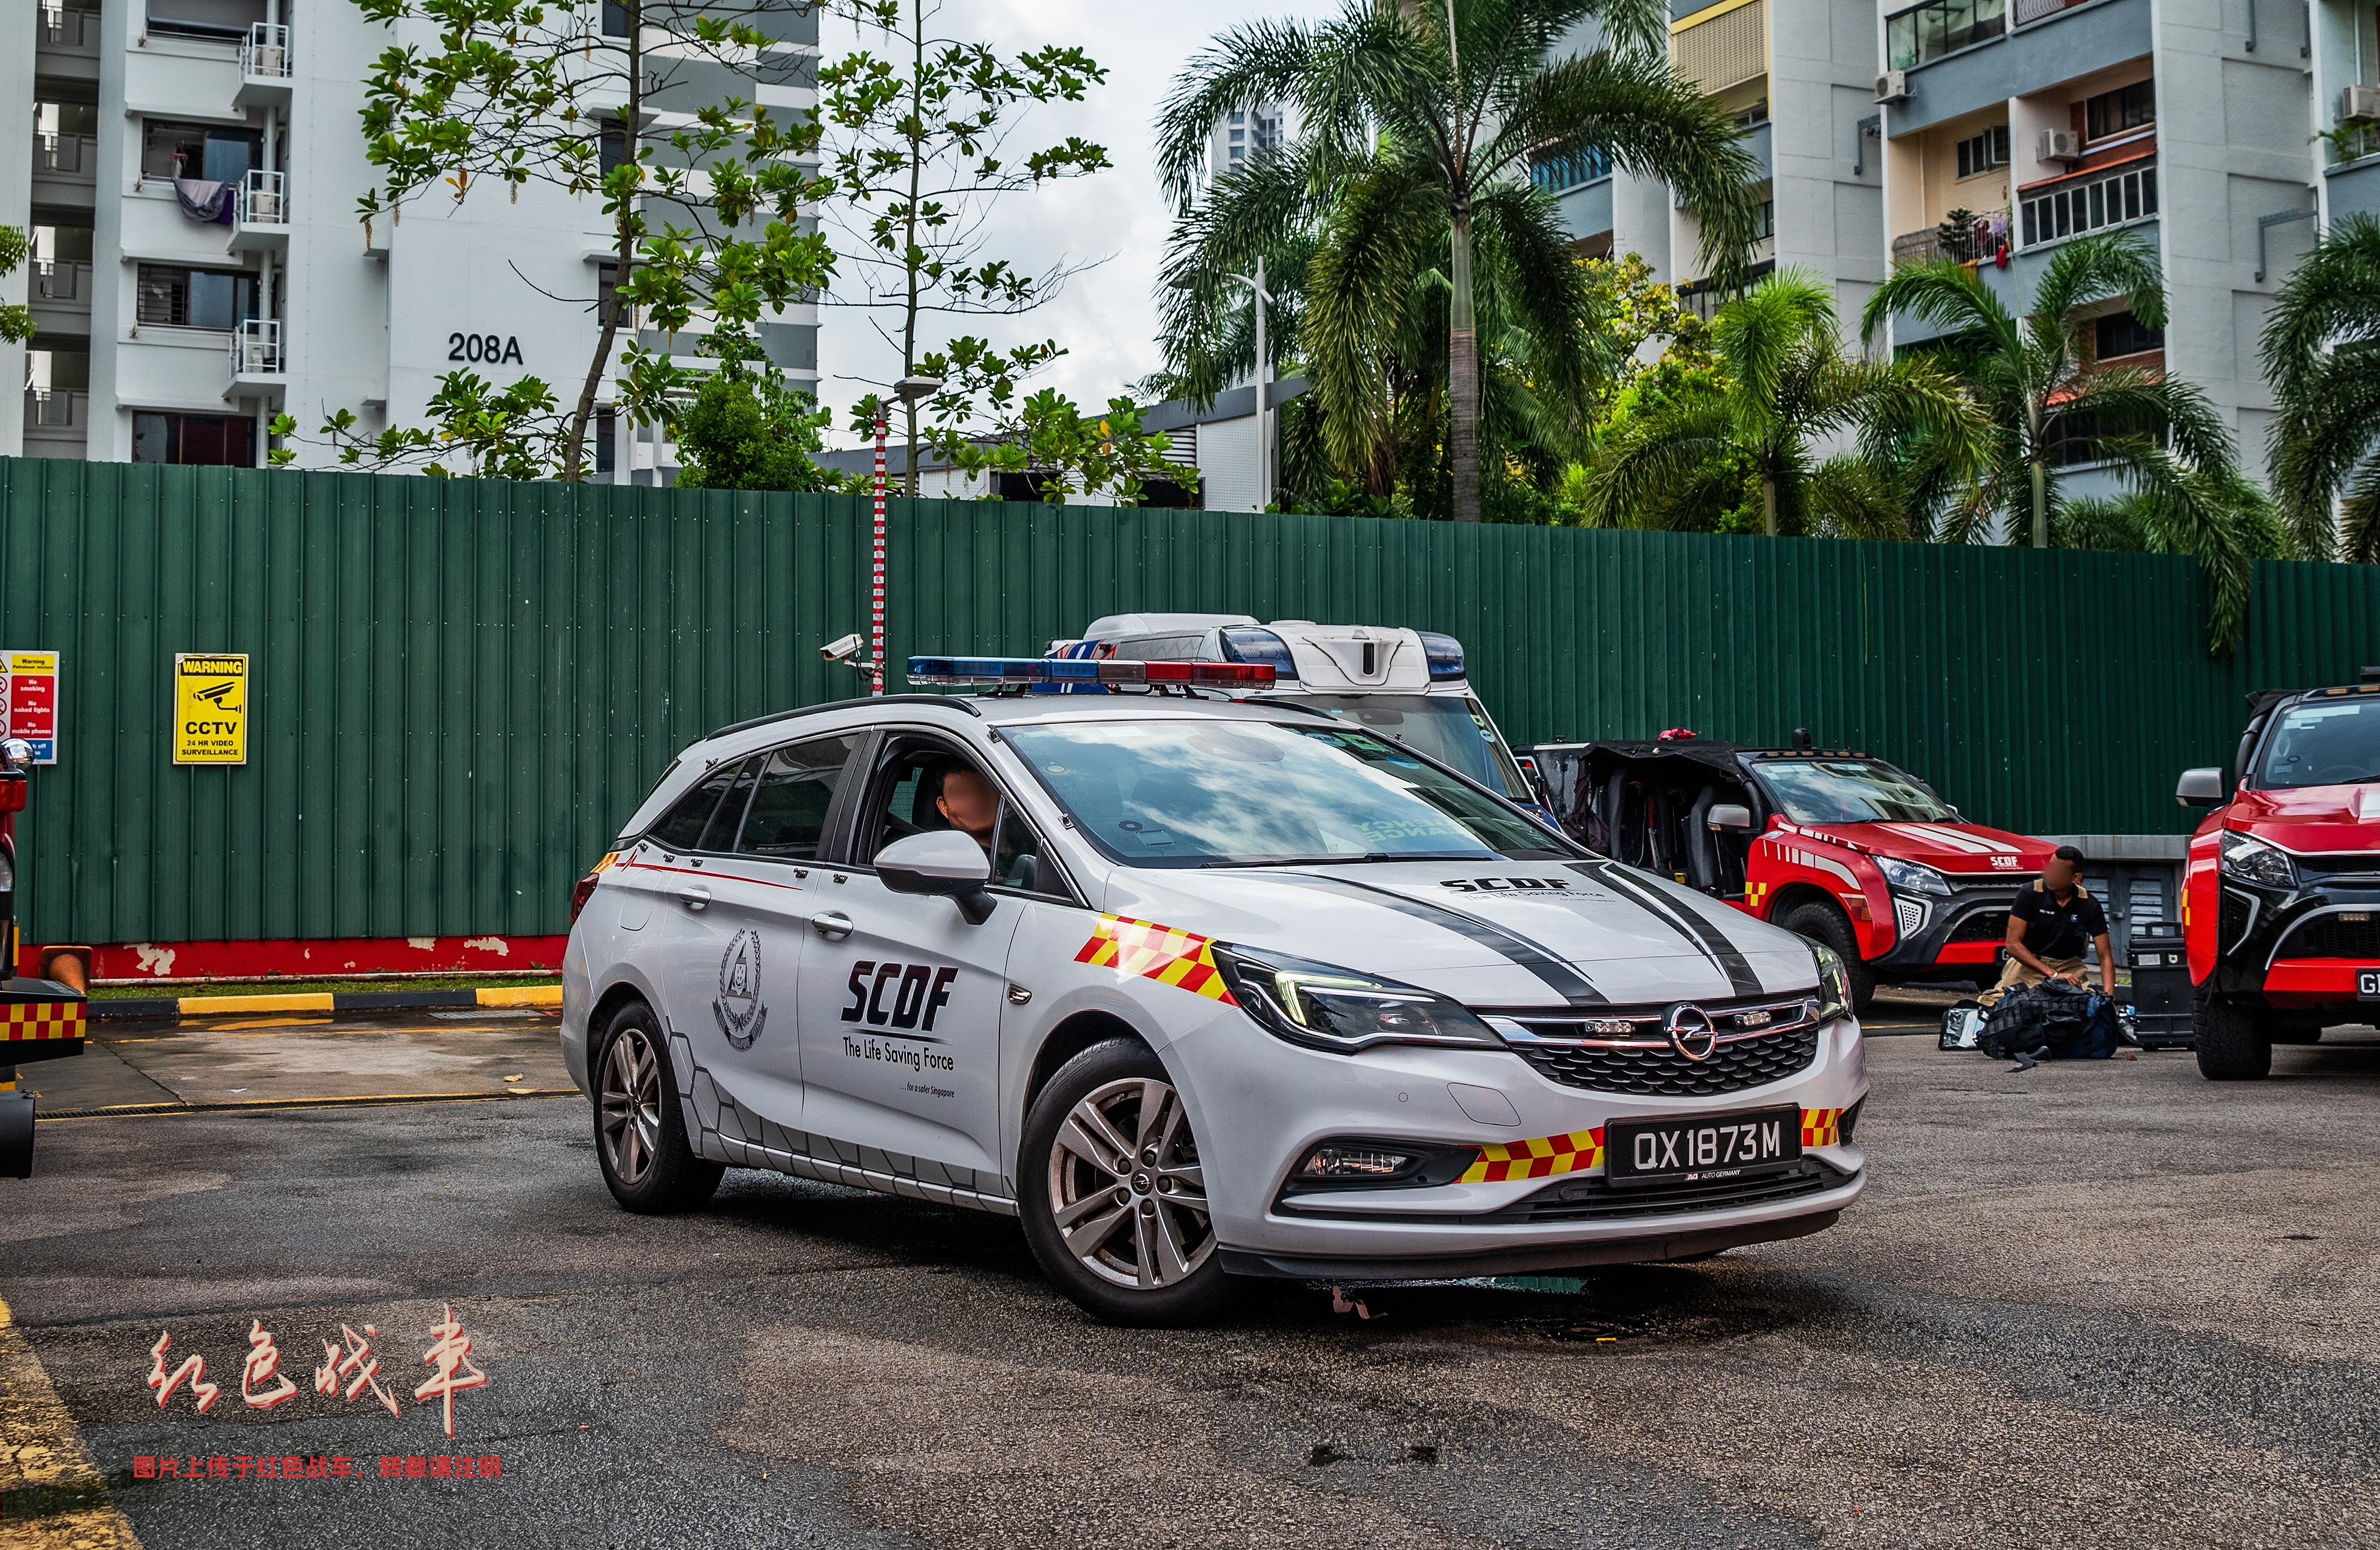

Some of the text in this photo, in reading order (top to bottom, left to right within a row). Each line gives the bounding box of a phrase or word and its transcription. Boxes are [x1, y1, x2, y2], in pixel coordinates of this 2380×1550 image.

[448, 332, 523, 365] 208A
[183, 661, 242, 673] WARNING
[185, 721, 237, 735] CCTV
[1990, 857, 2017, 866] SCDF
[1439, 877, 1570, 892] SCDF
[841, 960, 959, 1032] SCDF
[843, 1036, 954, 1072] The Life Saving Force
[919, 1084, 930, 1094] safer
[931, 1085, 955, 1098] Singapore
[1635, 1121, 1780, 1169] QX1873M
[1715, 1169, 1741, 1178] GERMANY
